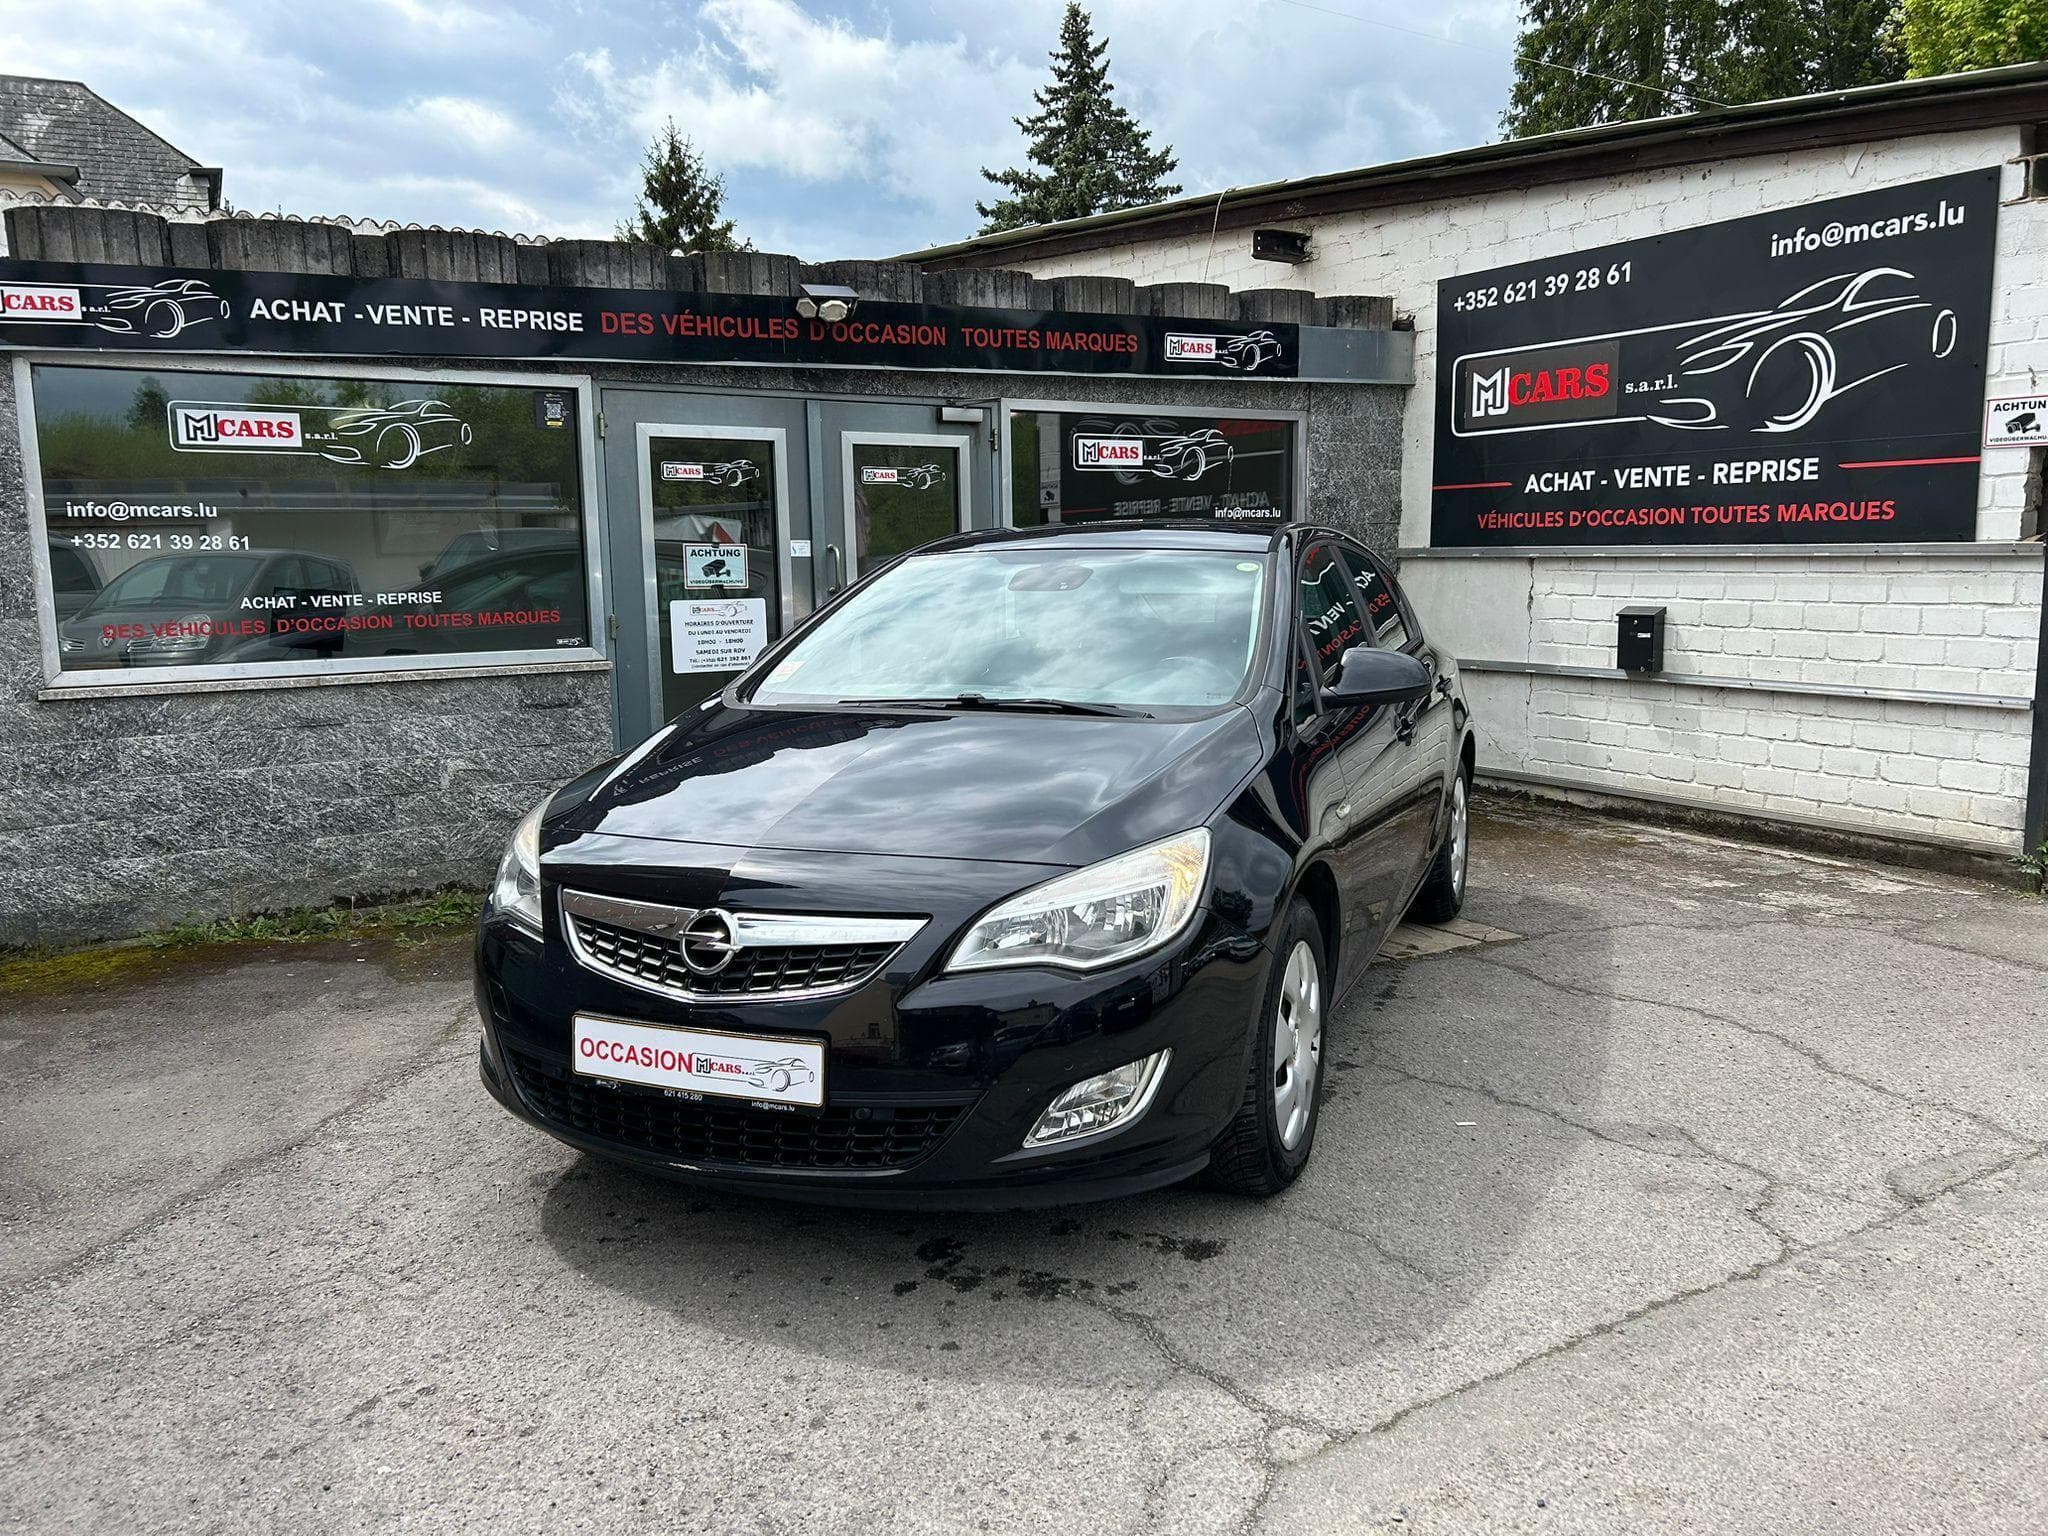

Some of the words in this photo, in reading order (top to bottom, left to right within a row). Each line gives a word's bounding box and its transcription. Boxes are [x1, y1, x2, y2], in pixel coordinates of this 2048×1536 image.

[1771, 200, 1965, 257] info@mcars.lu
[1454, 287, 1498, 312] +352
[1503, 279, 1537, 304] 621
[1544, 273, 1569, 297] 39
[1575, 267, 1600, 291] 28
[1606, 261, 1632, 285] 61
[1, 292, 75, 312] CARS
[250, 298, 345, 323] ACHAT
[479, 308, 584, 332] REPRISE
[600, 311, 654, 336] DES
[661, 308, 799, 340] VÉHICULES
[810, 320, 947, 347] D'OCCASION
[961, 327, 1041, 349] TOUTES
[1046, 331, 1139, 353] MARQUES
[1625, 374, 1679, 394] s.a.r.l.
[1994, 400, 2047, 412] ACHTUN
[1524, 470, 1596, 494] ACHAT
[1614, 465, 1691, 489] VENTE
[1713, 457, 1820, 485] REPRISE
[66, 502, 218, 521] info@mcars.lu
[1215, 507, 1281, 520] info@mcars.lu
[1477, 509, 1564, 529] VÉHICULES
[1569, 507, 1685, 527] D'OCCASION
[1691, 505, 1770, 524] TOUTES
[1777, 500, 1896, 522] MARQUES
[70, 533, 121, 549] +352
[127, 534, 162, 550] 621
[170, 535, 193, 550] 39
[200, 535, 223, 550] 28
[228, 536, 250, 551] 61
[690, 549, 741, 557] ACHTUNG
[240, 596, 297, 610] ACHAT
[310, 594, 364, 609] VENTE
[377, 591, 443, 606] REPRISE
[103, 623, 145, 640] DES
[152, 620, 266, 639] VÉHICULES
[277, 615, 394, 633] D'OCCASION
[404, 613, 473, 629] TOUTES
[478, 610, 561, 626] MARQUES
[580, 1037, 693, 1073] OCCASION
